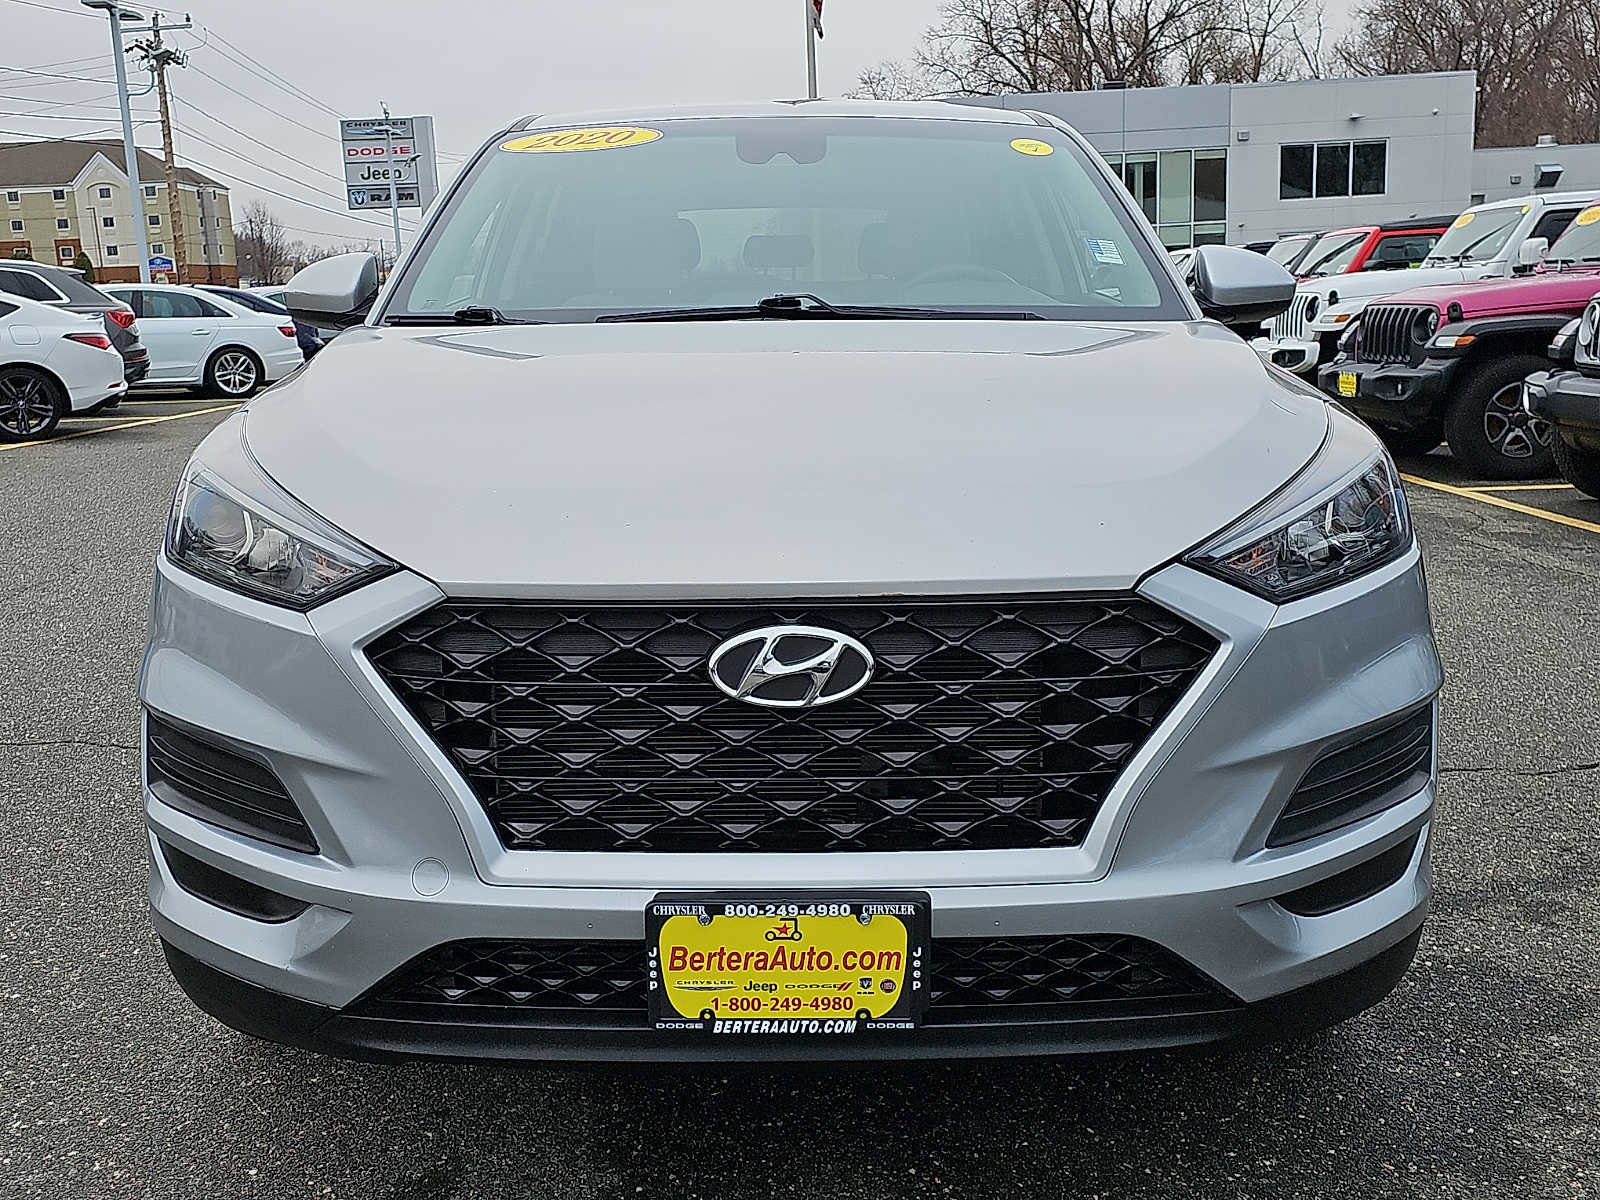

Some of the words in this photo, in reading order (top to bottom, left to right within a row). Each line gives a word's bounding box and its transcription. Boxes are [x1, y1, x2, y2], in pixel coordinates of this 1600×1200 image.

[524, 130, 636, 150] 2020
[652, 904, 706, 916] CHRYSLER
[724, 904, 851, 917] 800-249-4980
[862, 904, 916, 916] CHRYSLER
[668, 946, 901, 972] BerteraAuto.com
[648, 948, 658, 991] Jeep
[912, 947, 922, 991] Jeep
[743, 981, 778, 993] Jeep
[711, 997, 853, 1011] 1-800-249-4980
[713, 1020, 858, 1034] BERTERAAUTO.COM
